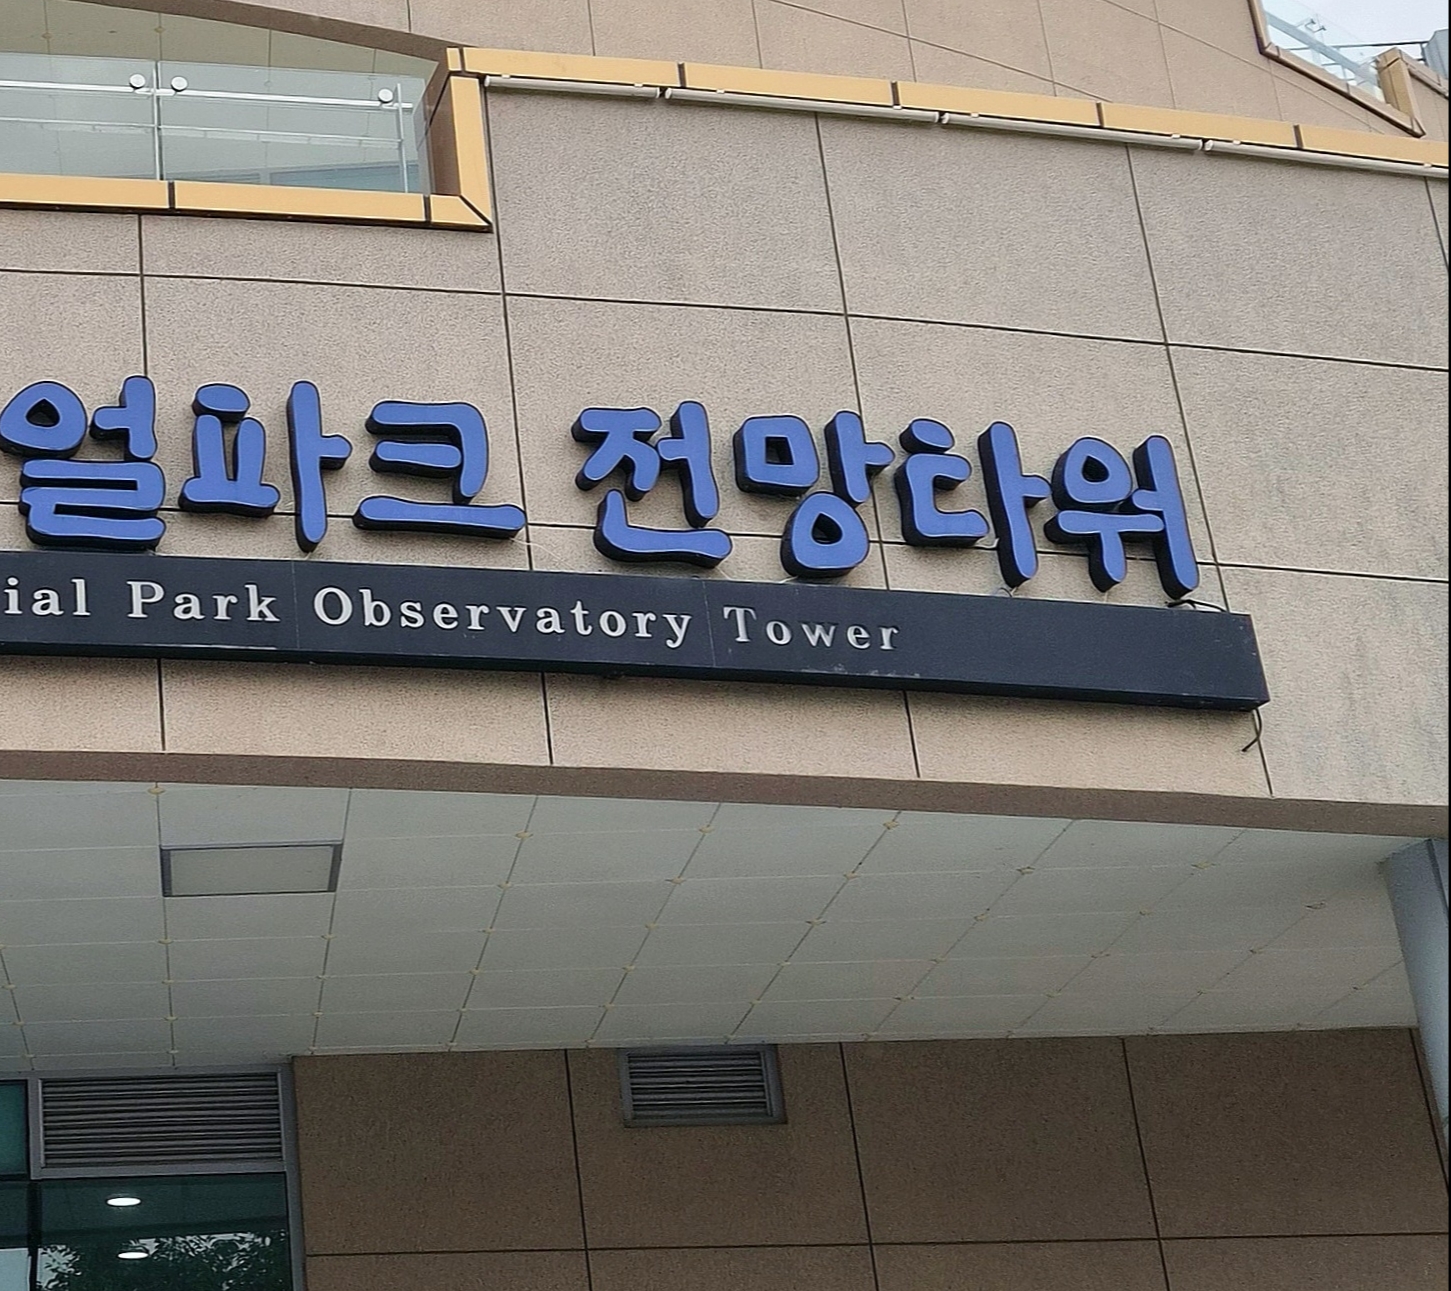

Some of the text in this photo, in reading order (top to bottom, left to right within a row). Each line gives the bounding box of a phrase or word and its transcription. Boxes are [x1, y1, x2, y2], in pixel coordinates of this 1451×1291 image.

[571, 400, 1200, 600] 전망타워
[127, 581, 280, 623] Park
[314, 587, 692, 650] Observatory
[724, 606, 900, 652] Tower
